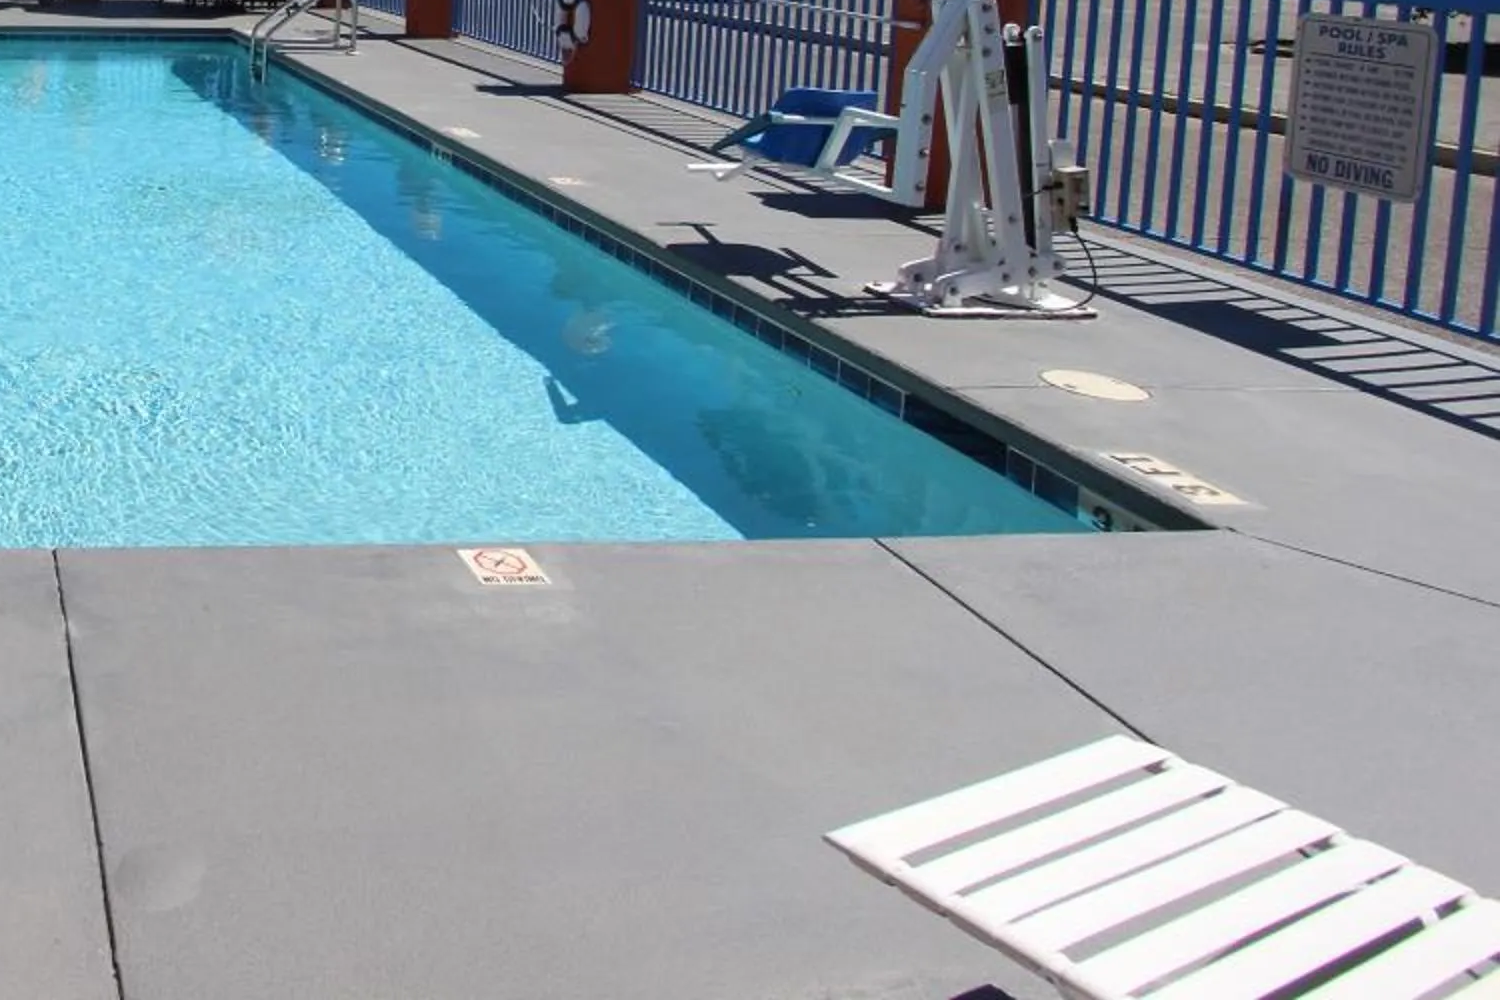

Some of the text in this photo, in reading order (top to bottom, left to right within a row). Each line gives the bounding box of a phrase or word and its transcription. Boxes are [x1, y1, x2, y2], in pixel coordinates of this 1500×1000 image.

[1319, 25, 1363, 41] POOL
[1378, 32, 1408, 47] SPA
[1338, 41, 1387, 59] RULES
[1306, 153, 1394, 189] NO DIVING
